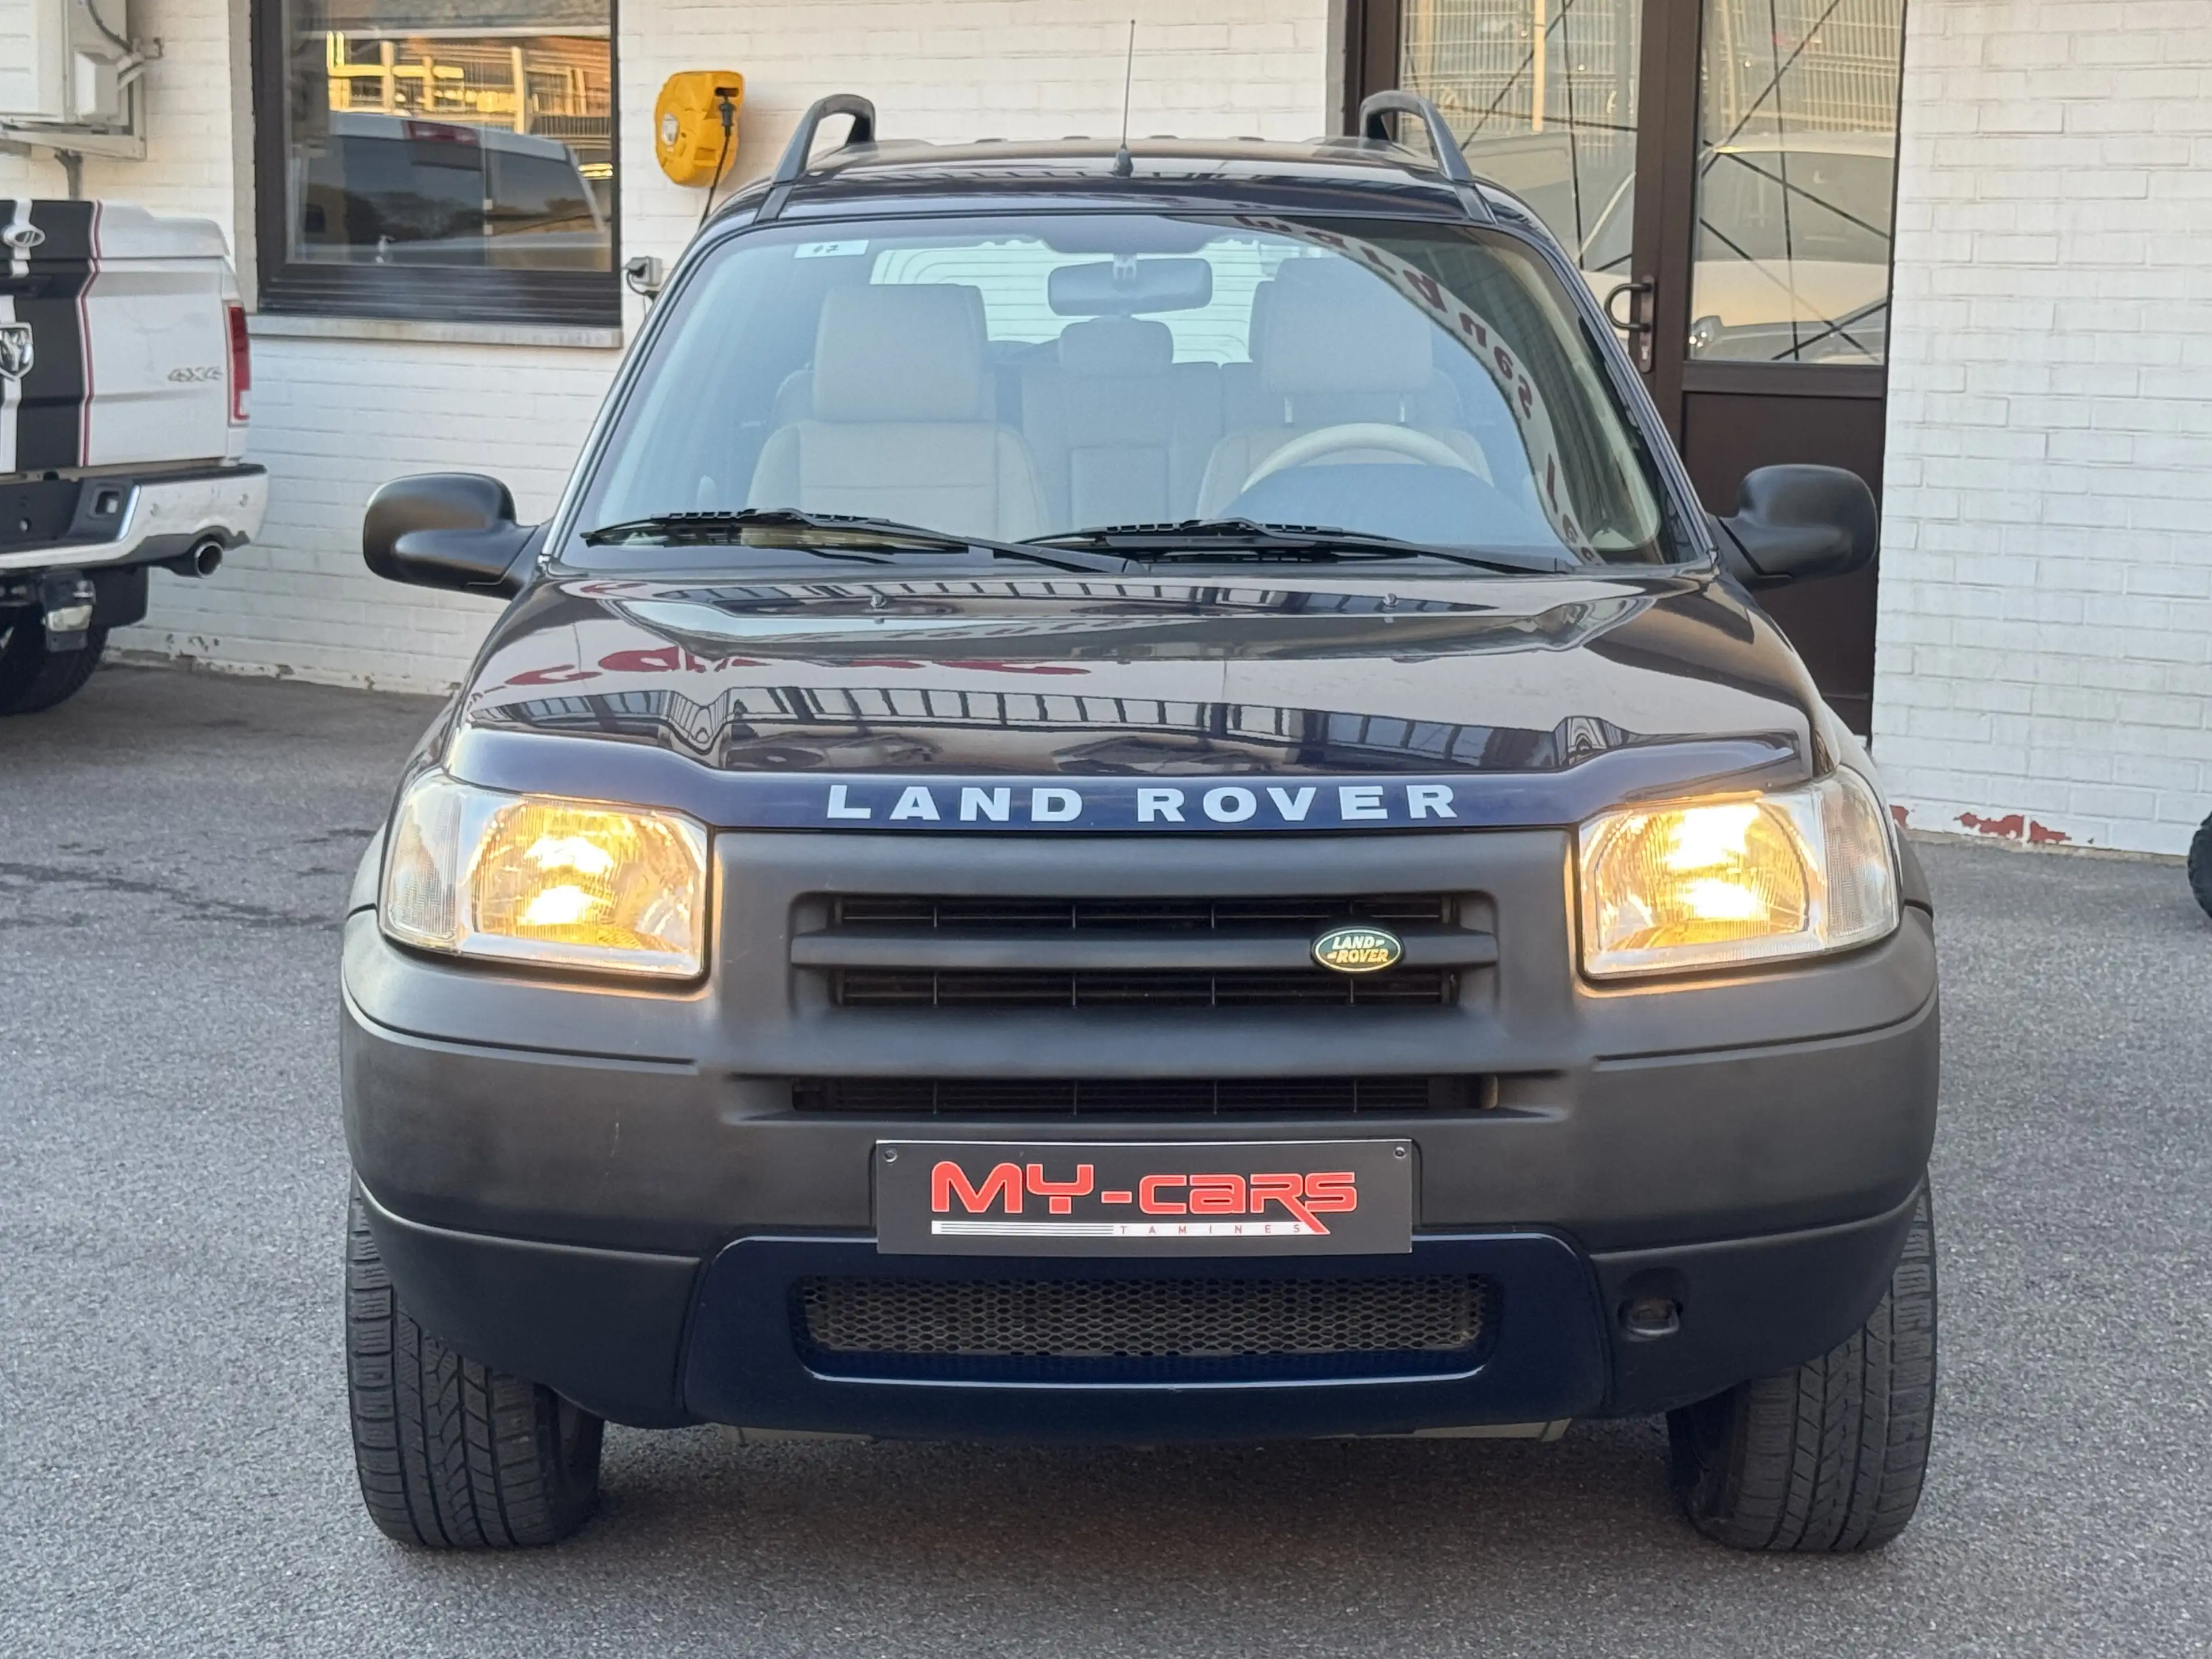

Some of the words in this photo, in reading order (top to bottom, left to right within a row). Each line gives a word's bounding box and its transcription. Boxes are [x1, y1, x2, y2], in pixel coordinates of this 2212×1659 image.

[827, 785, 1082, 821] LAND
[1137, 785, 1458, 822] ROVER
[1335, 948, 1389, 963] ROVER
[1120, 1224, 1301, 1234] TAMINES
